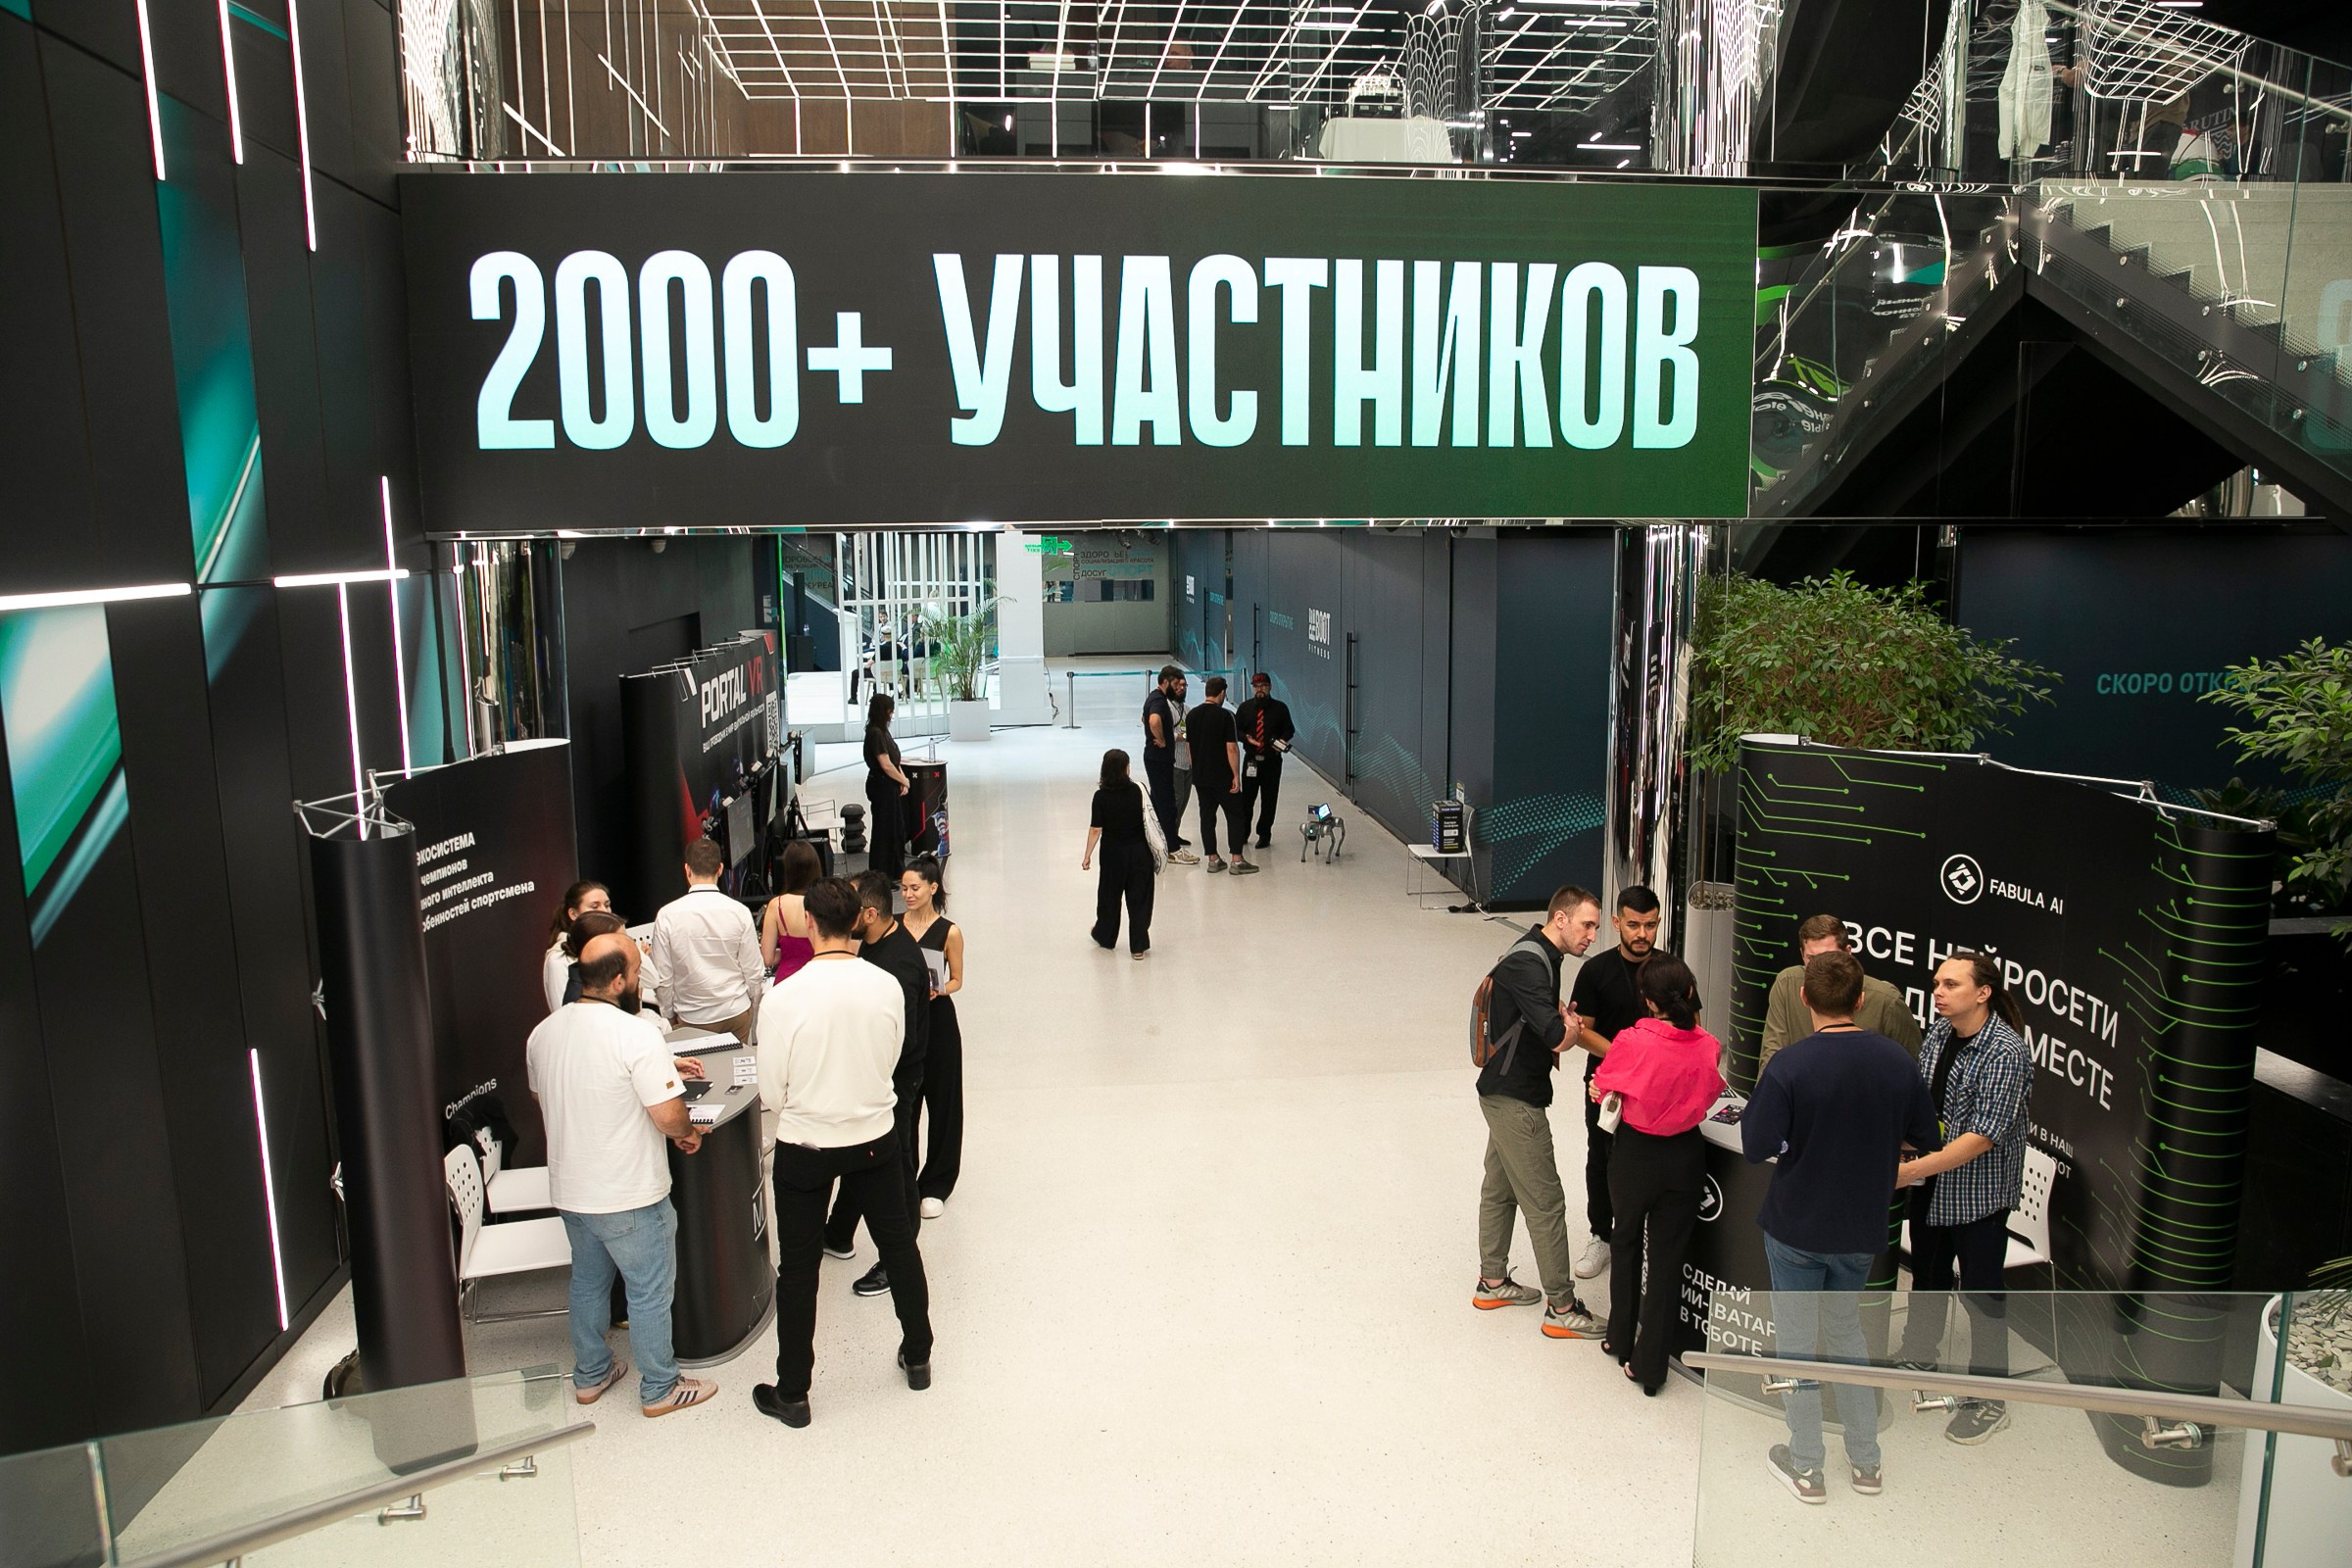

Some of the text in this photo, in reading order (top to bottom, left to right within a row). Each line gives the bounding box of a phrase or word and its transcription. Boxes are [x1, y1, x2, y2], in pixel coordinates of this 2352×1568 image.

[470, 250, 1699, 450] 2000+ УЧАСТНИКОВ
[702, 656, 763, 728] PORTAL VR
[2096, 673, 2173, 694] СКОРО
[420, 859, 467, 886] чемпионов
[442, 871, 494, 900] интеллекта
[470, 881, 535, 907] спортсмена
[1989, 879, 2064, 914] FABULA AI
[1842, 921, 1915, 966] ВСЕ
[1928, 938, 2118, 1048] НРОСЕТИ
[2024, 1025, 2114, 1110] МЕСТЕ
[2040, 1127, 2048, 1142] В
[2050, 1133, 2074, 1158] НАШ
[2052, 1156, 2072, 1179] ОТ
[1683, 1263, 1751, 1305] СДЕЛАЙ
[1681, 1284, 1776, 1338] ИИ-ВАТАР
[1681, 1305, 1689, 1323] В
